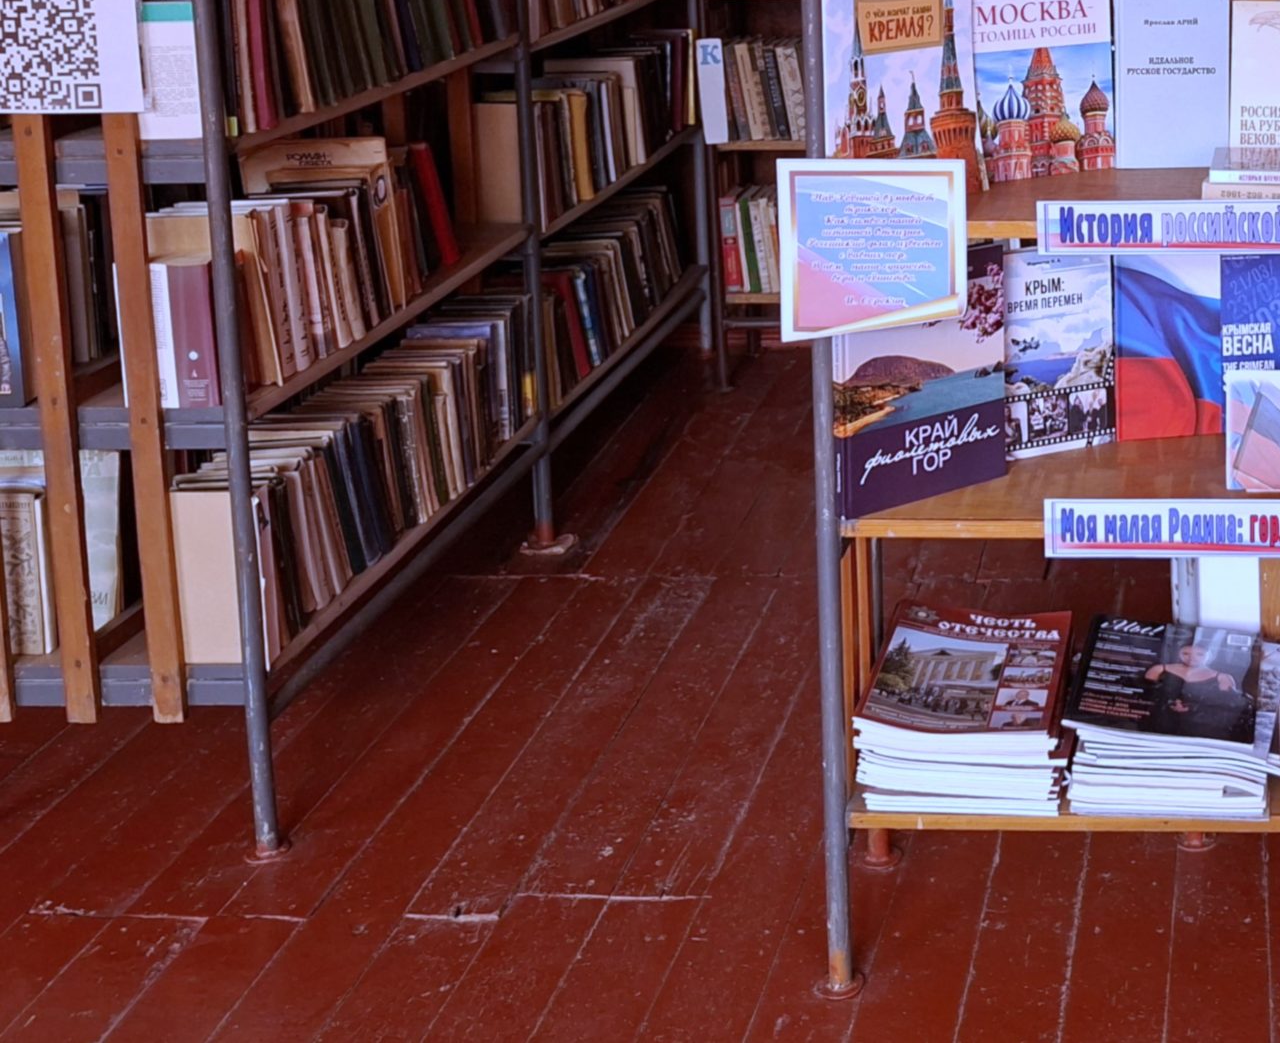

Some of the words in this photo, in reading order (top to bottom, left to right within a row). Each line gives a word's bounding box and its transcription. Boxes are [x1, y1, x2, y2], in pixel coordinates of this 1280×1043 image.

[868, 14, 934, 44] КРЕМЛЯ?
[974, 27, 1036, 44] ТОЛИЦА
[1040, 23, 1097, 38] РОССИИ
[699, 44, 721, 66] К
[1149, 57, 1195, 65] ИДЕАЛЬНОЕ
[1127, 68, 1161, 76] РУССКОЕ
[1163, 67, 1217, 76] ГОСУДАРСТВО
[1240, 120, 1258, 132] НА
[1059, 206, 1153, 247] История
[1025, 276, 1065, 297] КРЫМ:
[1007, 296, 1039, 314] ВРЕМЯ
[1041, 292, 1083, 310] ПЕРЕМЕН
[1222, 322, 1272, 335] КРЫМСКАЯ
[1222, 335, 1274, 357] ВЕСНА
[904, 415, 959, 448] КРАЙ
[860, 413, 1000, 485] фиолетовых
[912, 449, 952, 475] ГОР
[1060, 508, 1097, 543] Моя
[1104, 514, 1162, 544] малая
[1168, 508, 1244, 544] Родина:
